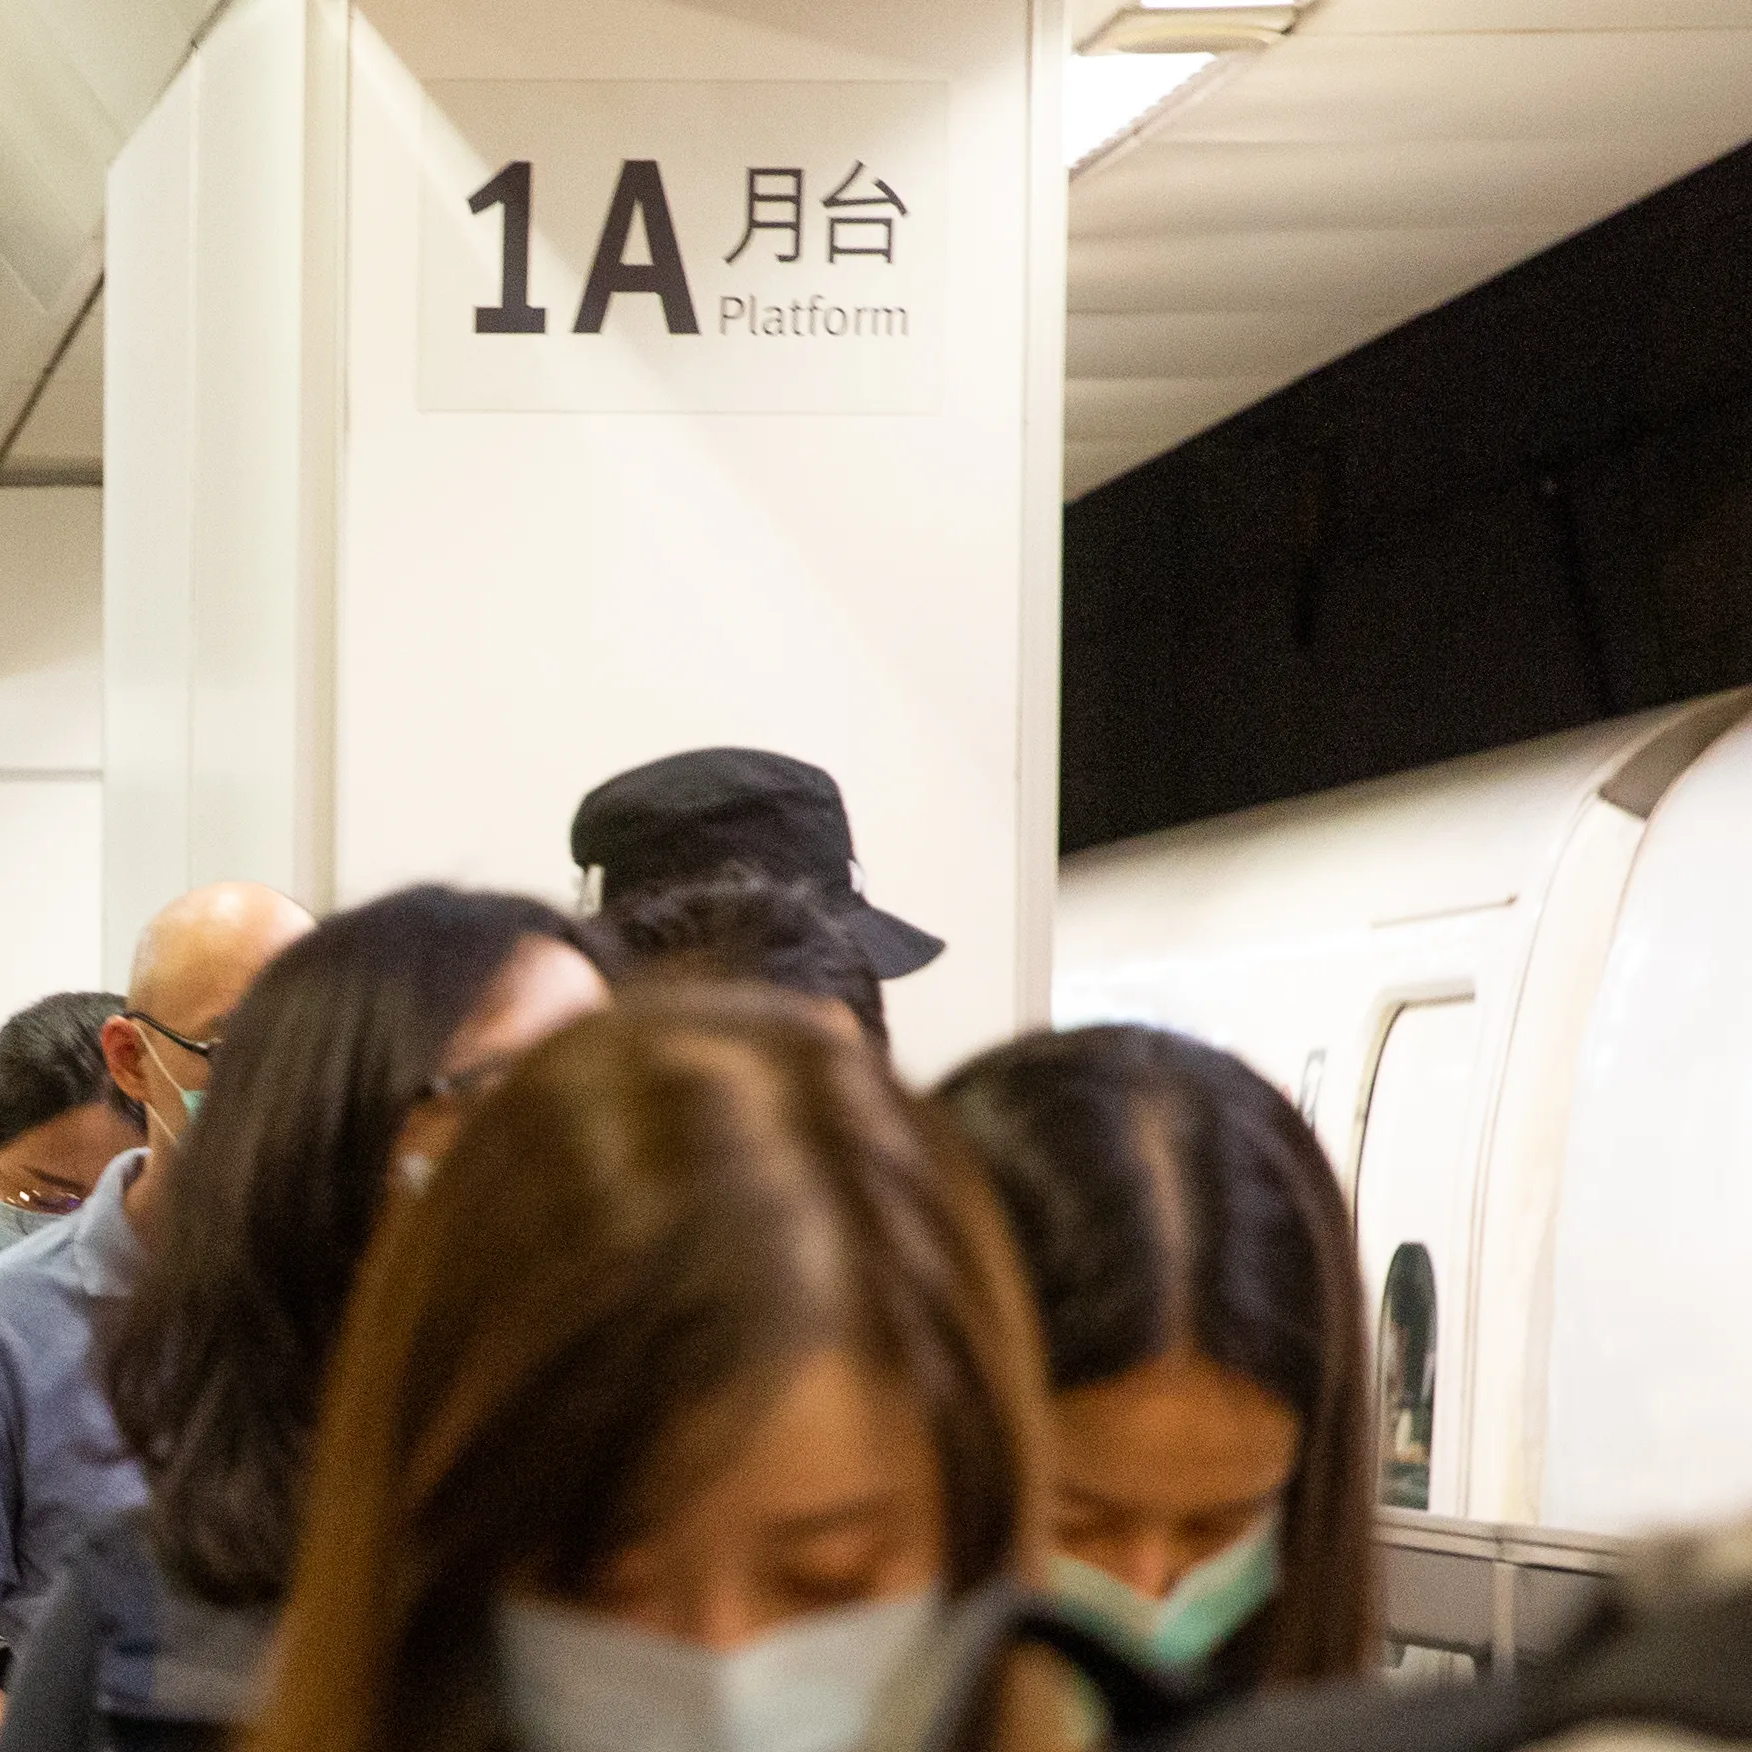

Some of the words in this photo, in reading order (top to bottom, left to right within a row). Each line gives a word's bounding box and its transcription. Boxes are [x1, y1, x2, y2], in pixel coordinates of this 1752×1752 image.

[466, 159, 701, 334] 1A
[723, 160, 909, 265] 月台
[719, 295, 909, 336] Platform
